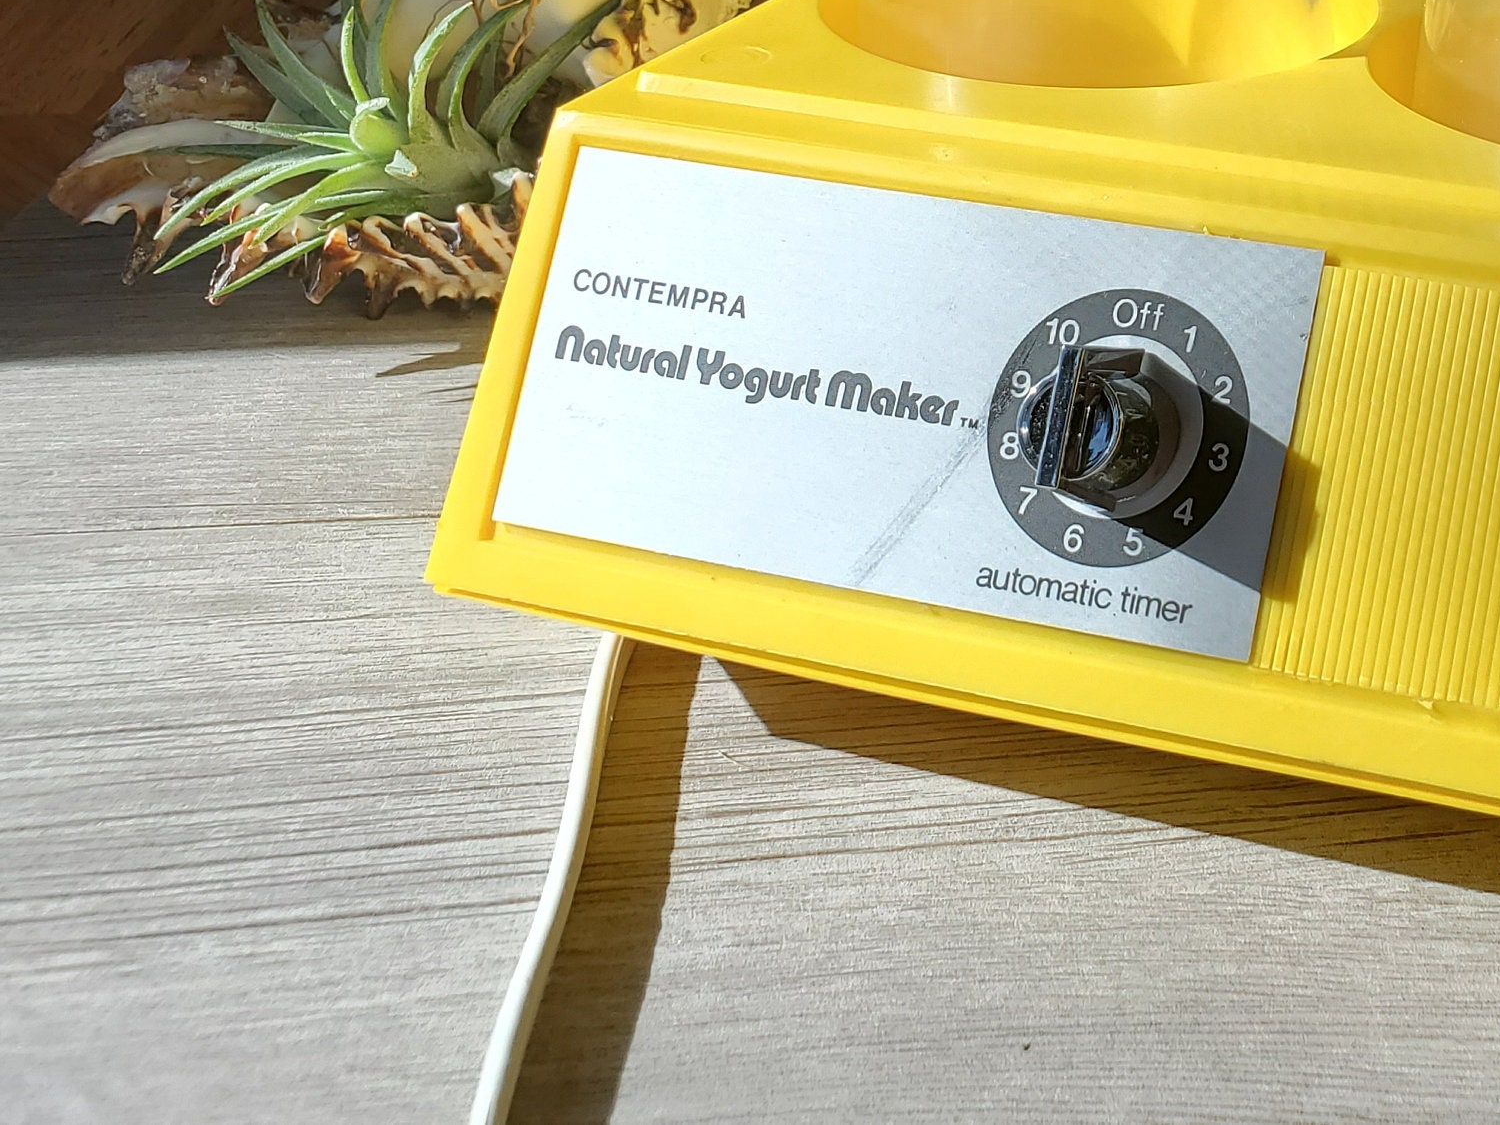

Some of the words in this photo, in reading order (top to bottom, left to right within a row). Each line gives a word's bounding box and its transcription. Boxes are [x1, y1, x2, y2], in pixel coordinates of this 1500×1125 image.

[573, 268, 747, 319] CONTEMPRA
[1112, 298, 1165, 331] Off
[1046, 319, 1080, 346] 10
[1183, 325, 1198, 353] 1
[555, 325, 693, 380] Natural
[696, 348, 821, 404] Yogurt
[825, 370, 959, 426] Maker
[1011, 370, 1032, 398] 9
[1214, 376, 1233, 404] 2
[999, 432, 1019, 460] 8
[1208, 443, 1229, 472] 3
[1017, 487, 1037, 515] 7
[1173, 498, 1194, 525] 4
[1063, 524, 1085, 553] 6
[1122, 528, 1144, 556] 5
[975, 566, 1113, 610] automatic
[1121, 586, 1193, 625] timer
